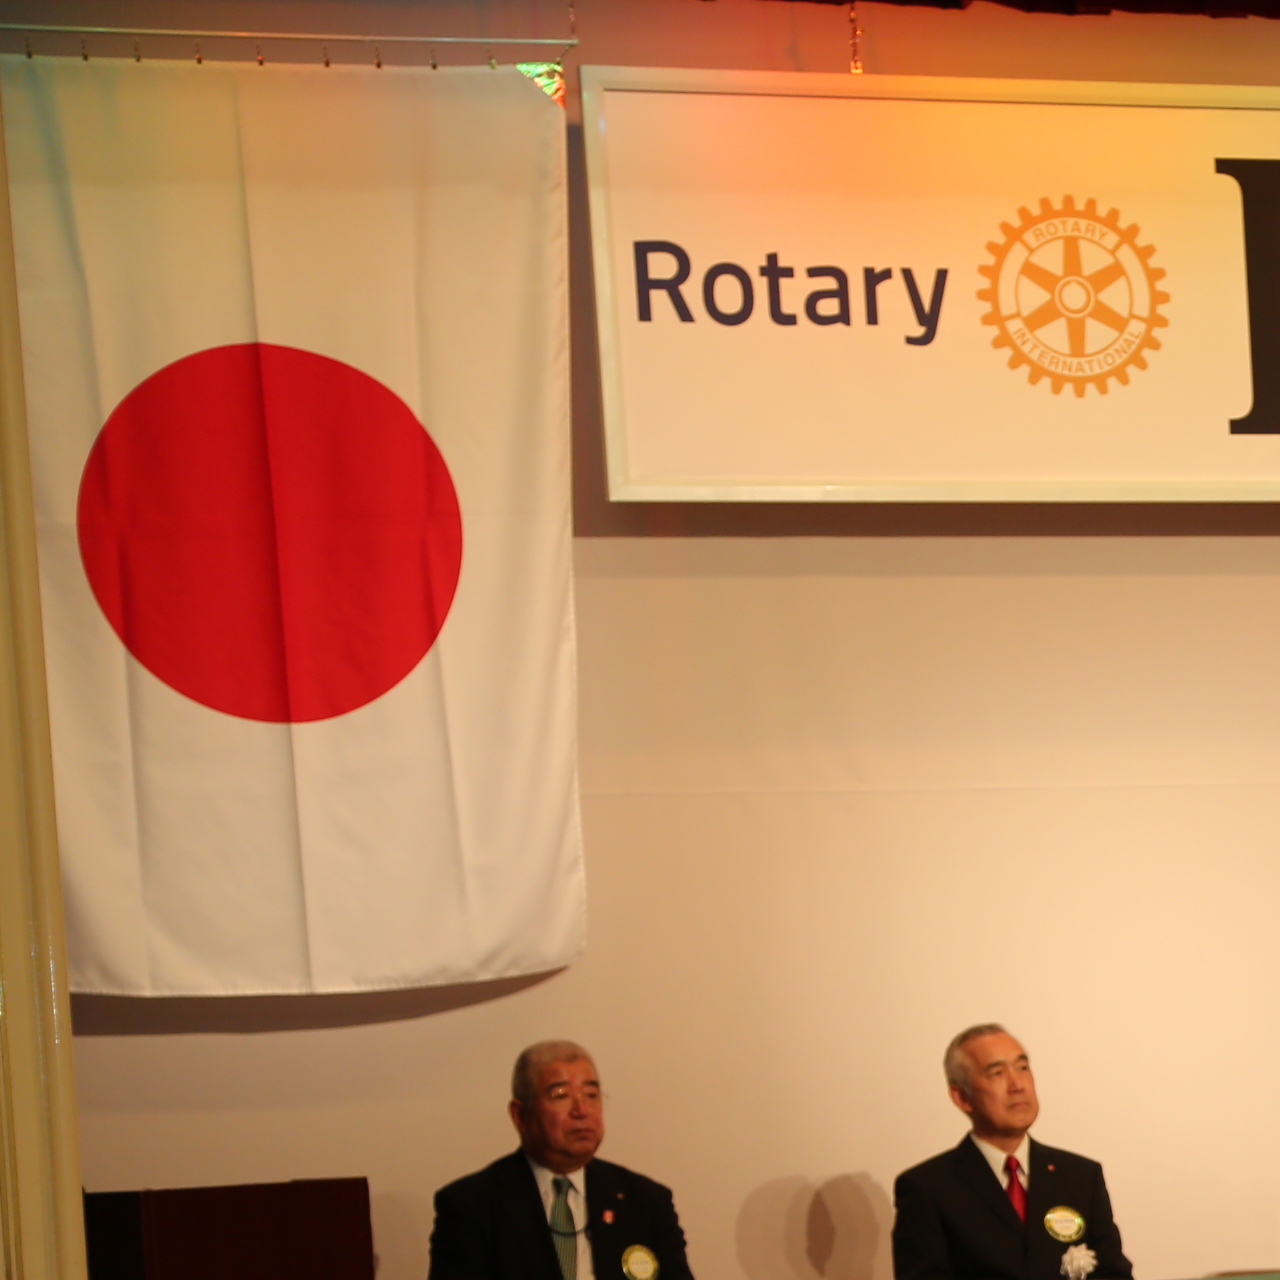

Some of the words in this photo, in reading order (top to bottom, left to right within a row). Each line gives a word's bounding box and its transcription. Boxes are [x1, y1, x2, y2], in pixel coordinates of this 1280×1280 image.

[1032, 219, 1110, 243] ROTARY
[631, 239, 950, 347] Rotary
[1012, 326, 1142, 375] INTERNATIONAL
